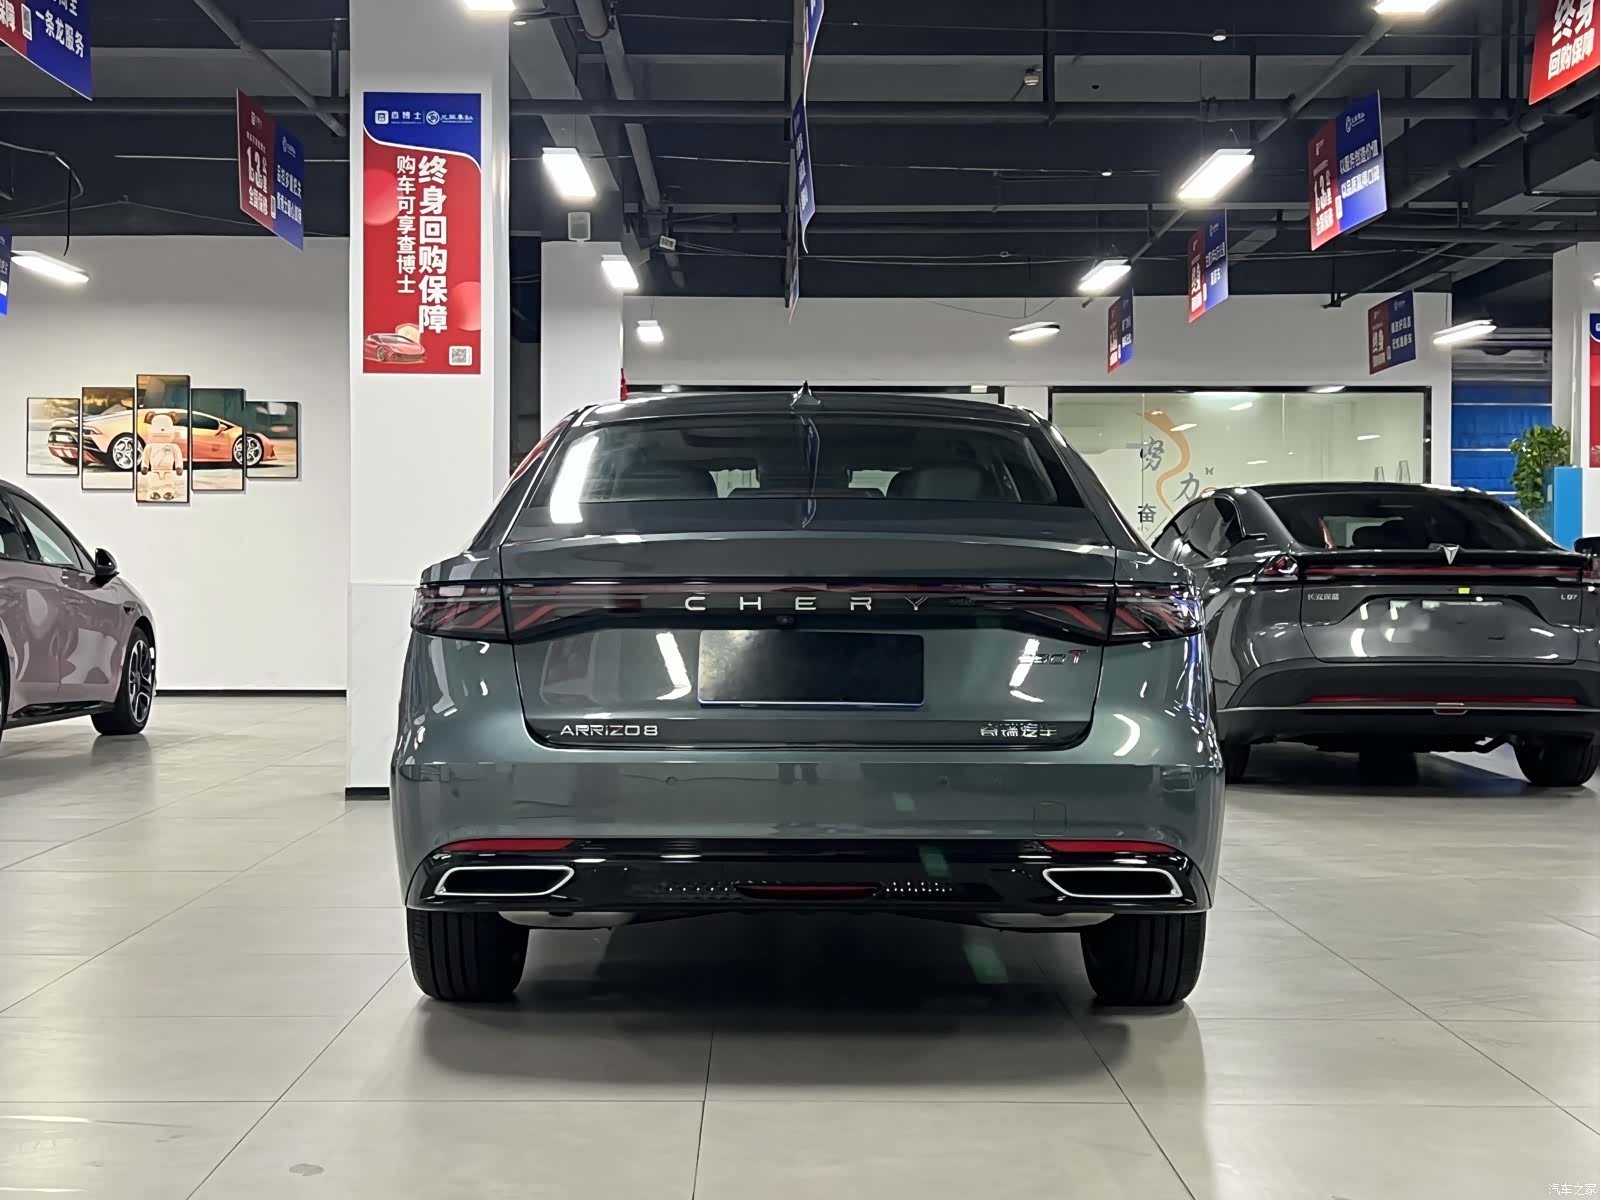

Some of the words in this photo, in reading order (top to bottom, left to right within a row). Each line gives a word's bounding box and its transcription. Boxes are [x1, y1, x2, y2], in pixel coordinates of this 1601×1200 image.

[35, 10, 84, 58] 一条龙服务
[1548, 28, 1594, 80] 回购保障
[396, 155, 416, 293] 购车可享查博士
[418, 155, 448, 334] 终身回购保障
[684, 595, 928, 611] CHERY
